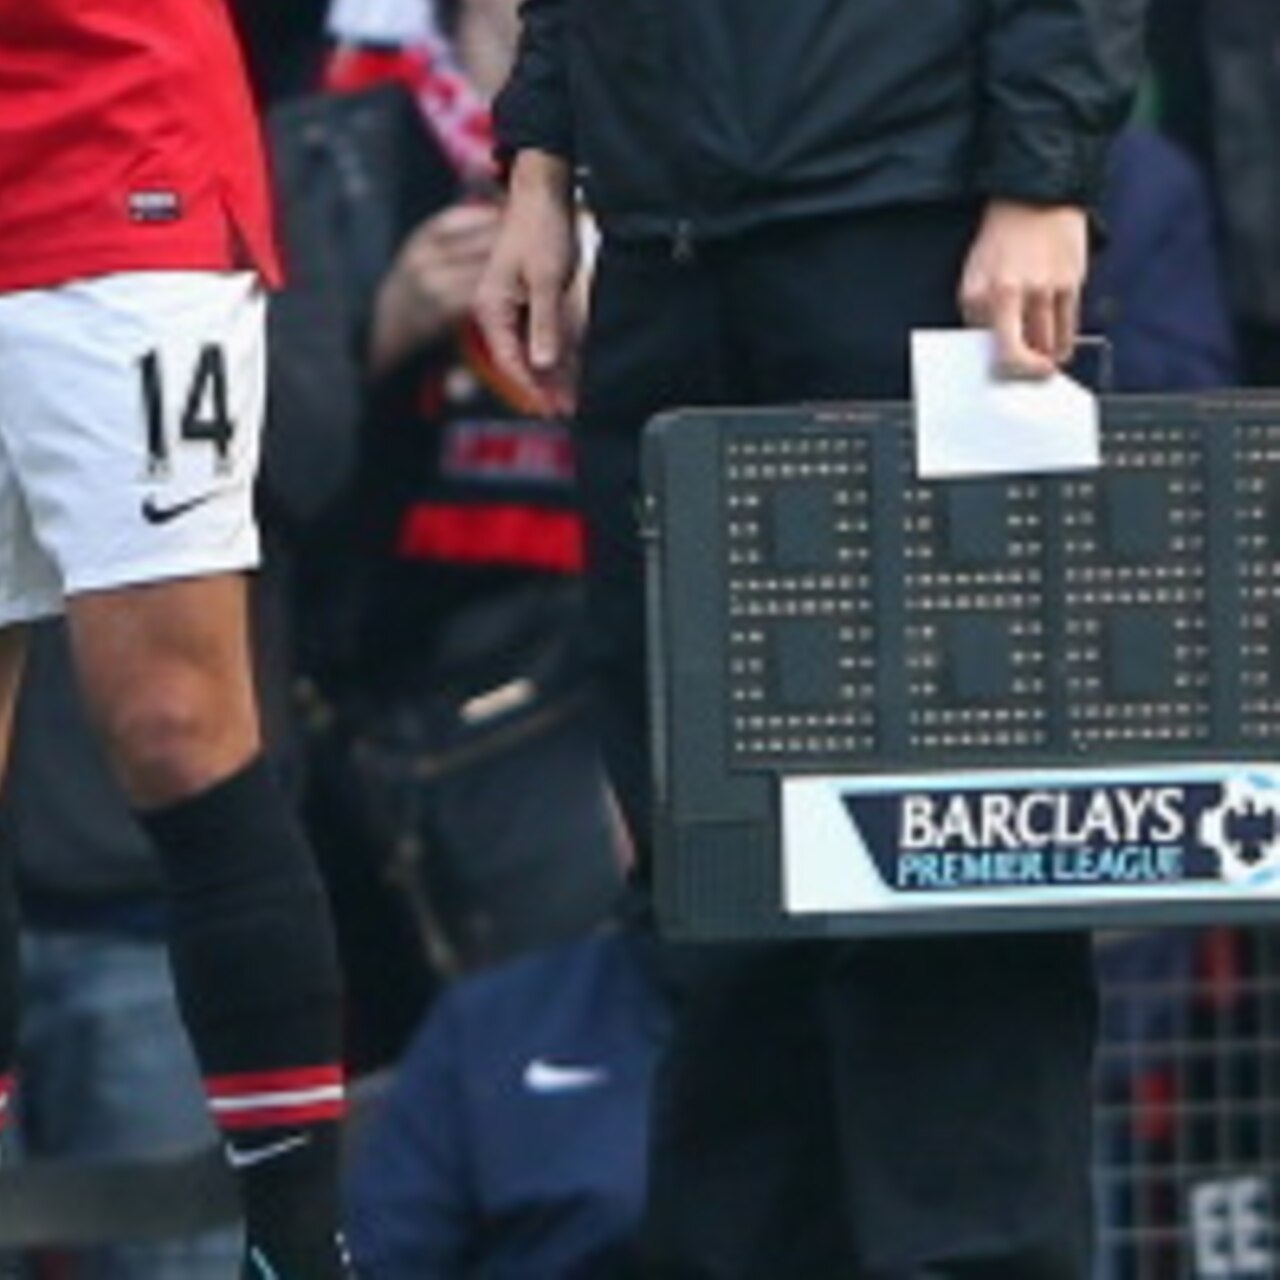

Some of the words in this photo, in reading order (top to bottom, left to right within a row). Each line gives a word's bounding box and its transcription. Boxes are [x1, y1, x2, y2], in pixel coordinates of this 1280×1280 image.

[138, 343, 234, 476] 14
[897, 787, 1185, 848] BARCLAYS
[897, 850, 1043, 887] PREMIER
[1052, 845, 1183, 881] LEAGUE
